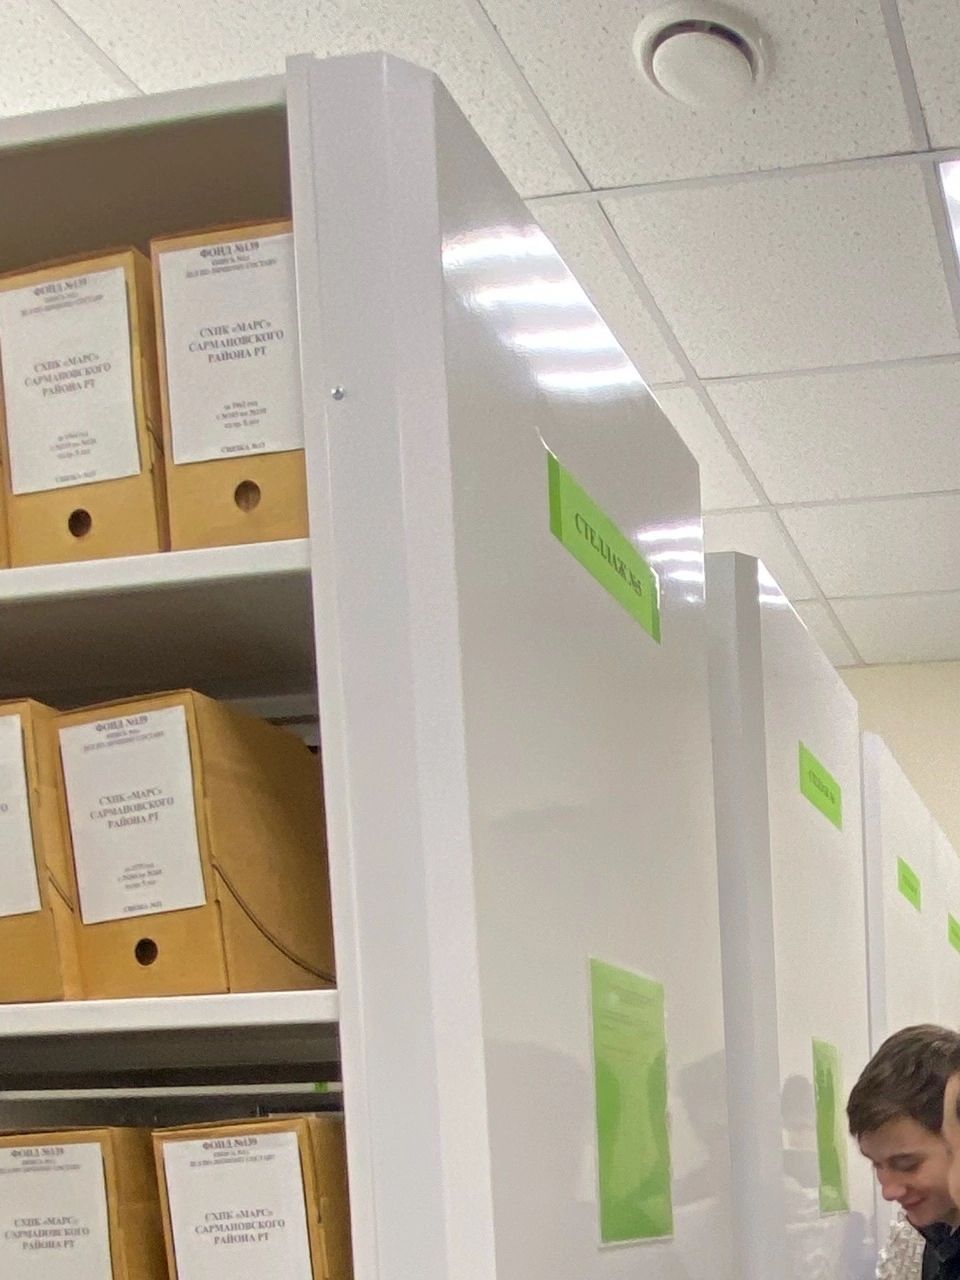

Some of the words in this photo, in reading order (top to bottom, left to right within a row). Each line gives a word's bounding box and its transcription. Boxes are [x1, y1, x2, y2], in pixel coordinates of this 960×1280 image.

[199, 325, 230, 338] СХПК
[188, 329, 285, 353] САРМАНОВСКОГО
[208, 348, 252, 363] РАЙОНА
[254, 346, 266, 357] РТ
[89, 796, 174, 821] САРМАНОВСКОГО
[107, 815, 147, 830] РАЙОНА
[148, 811, 159, 822] РТ
[204, 1211, 234, 1223] СХПК
[4, 1227, 90, 1240] САРМАНОВСКОГО
[194, 1219, 286, 1235] САРМАНОВСКОГО
[22, 1240, 62, 1250] РАЙОНА
[63, 1239, 75, 1249] РТ
[214, 1233, 256, 1245] РАЙОНА
[257, 1231, 269, 1242] РТ
